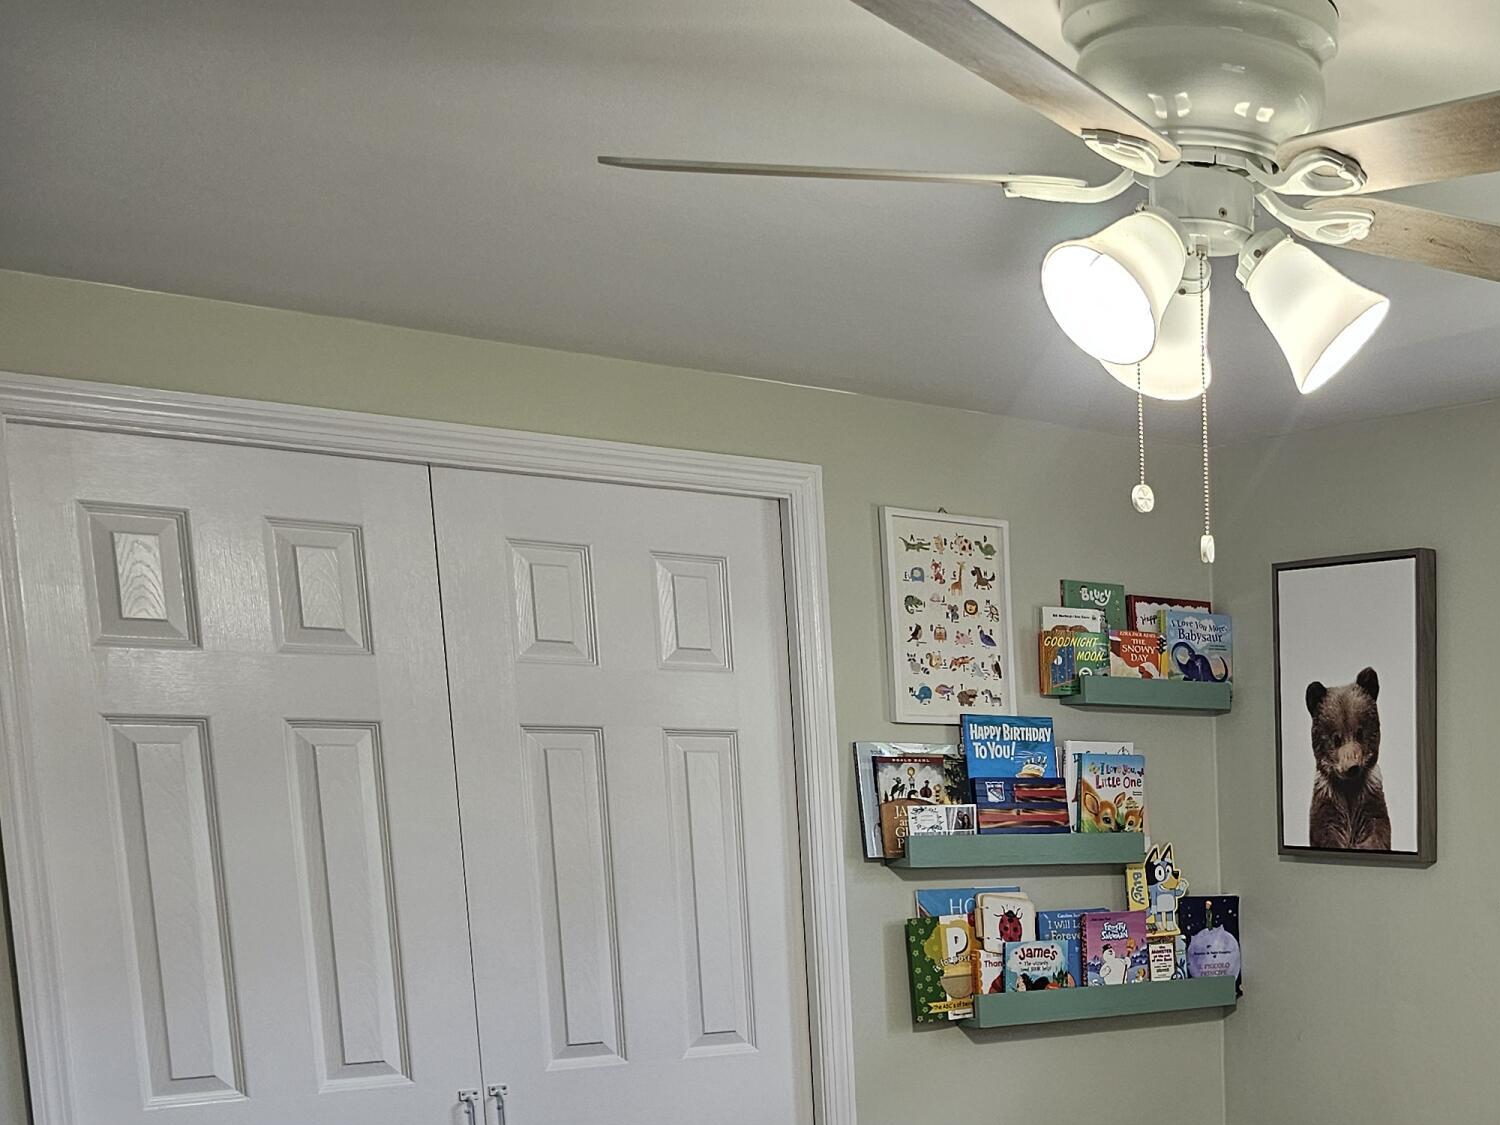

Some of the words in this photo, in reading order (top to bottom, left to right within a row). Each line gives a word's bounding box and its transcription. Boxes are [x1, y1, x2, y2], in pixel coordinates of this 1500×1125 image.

[1194, 621, 1209, 632] You
[1043, 636, 1099, 648] GOODNIGHT
[1178, 628, 1223, 644] Babysaur
[1121, 645, 1156, 654] SNOWY
[1076, 650, 1105, 662] MOON
[1130, 653, 1148, 662] DAY
[969, 723, 1001, 741] HAPPY
[1002, 723, 1051, 742] BIRTHDAY
[986, 741, 1016, 760] YOU!
[1122, 776, 1142, 789] One
[1054, 920, 1071, 929] Will
[946, 927, 968, 963] P
[984, 960, 1003, 968] Than
